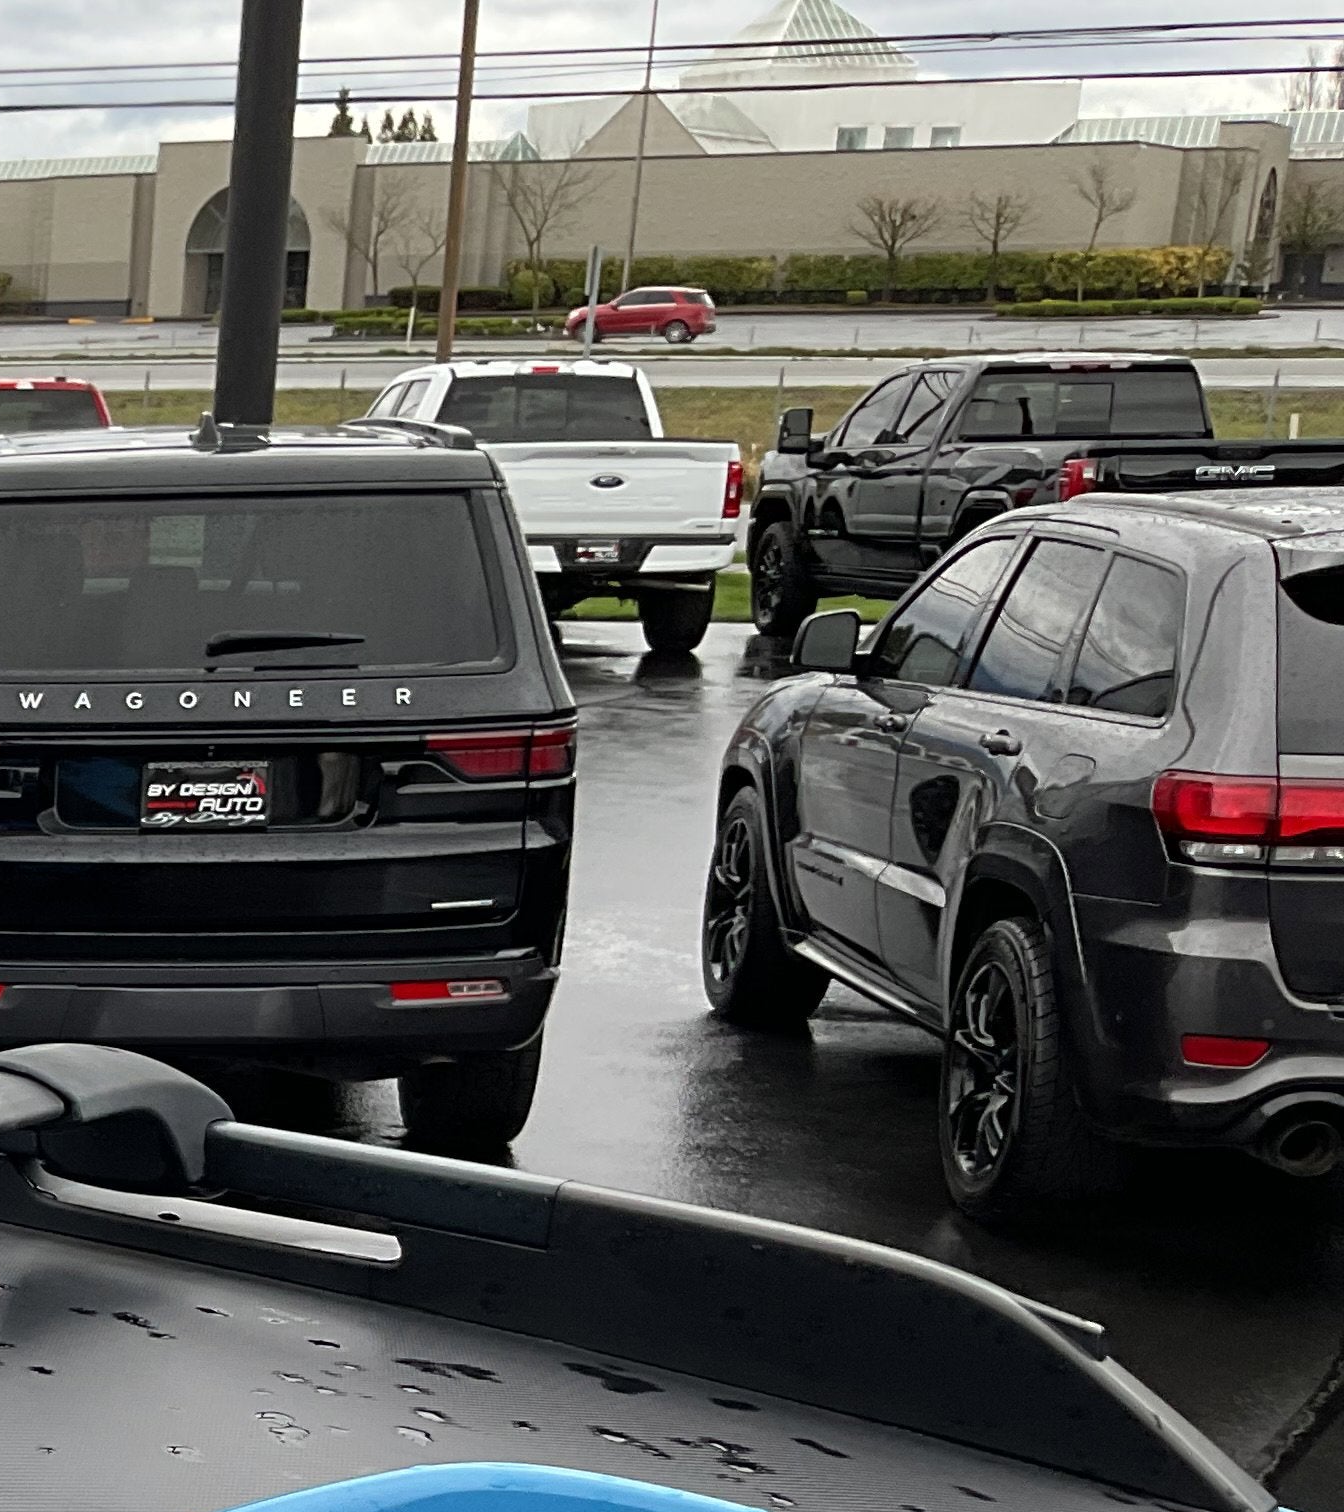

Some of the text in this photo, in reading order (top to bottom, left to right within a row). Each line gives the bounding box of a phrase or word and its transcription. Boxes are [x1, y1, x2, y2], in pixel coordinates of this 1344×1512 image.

[1194, 464, 1276, 481] GMC
[18, 687, 411, 710] WAGONEER
[147, 783, 252, 797] BY DESIGN
[198, 797, 264, 812] AUTO
